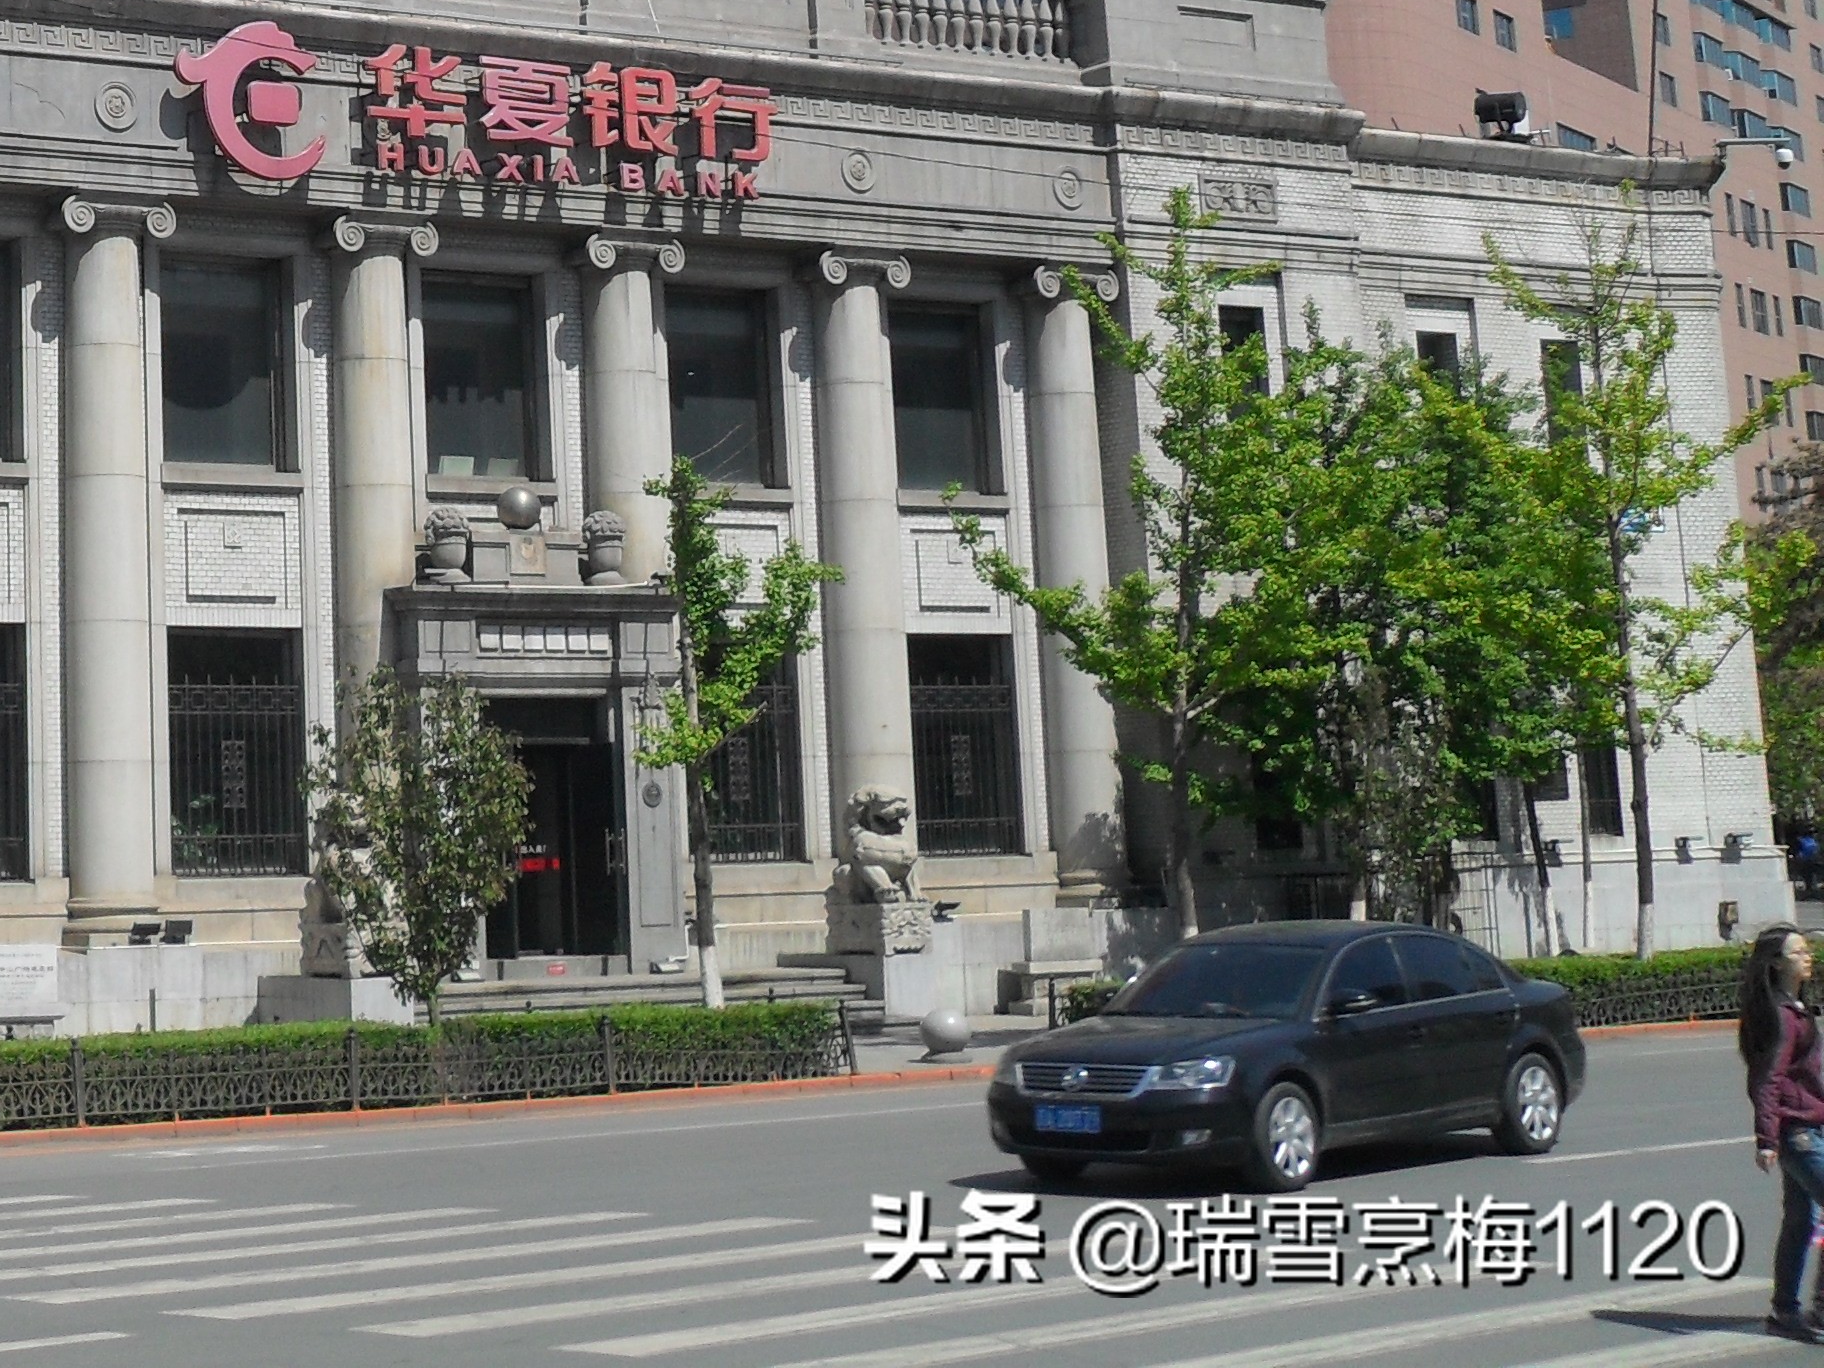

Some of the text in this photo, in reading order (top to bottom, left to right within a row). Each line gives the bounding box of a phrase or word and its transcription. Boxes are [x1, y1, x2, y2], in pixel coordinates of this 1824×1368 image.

[364, 43, 778, 163] 华夏银行
[619, 161, 761, 201] BANK
